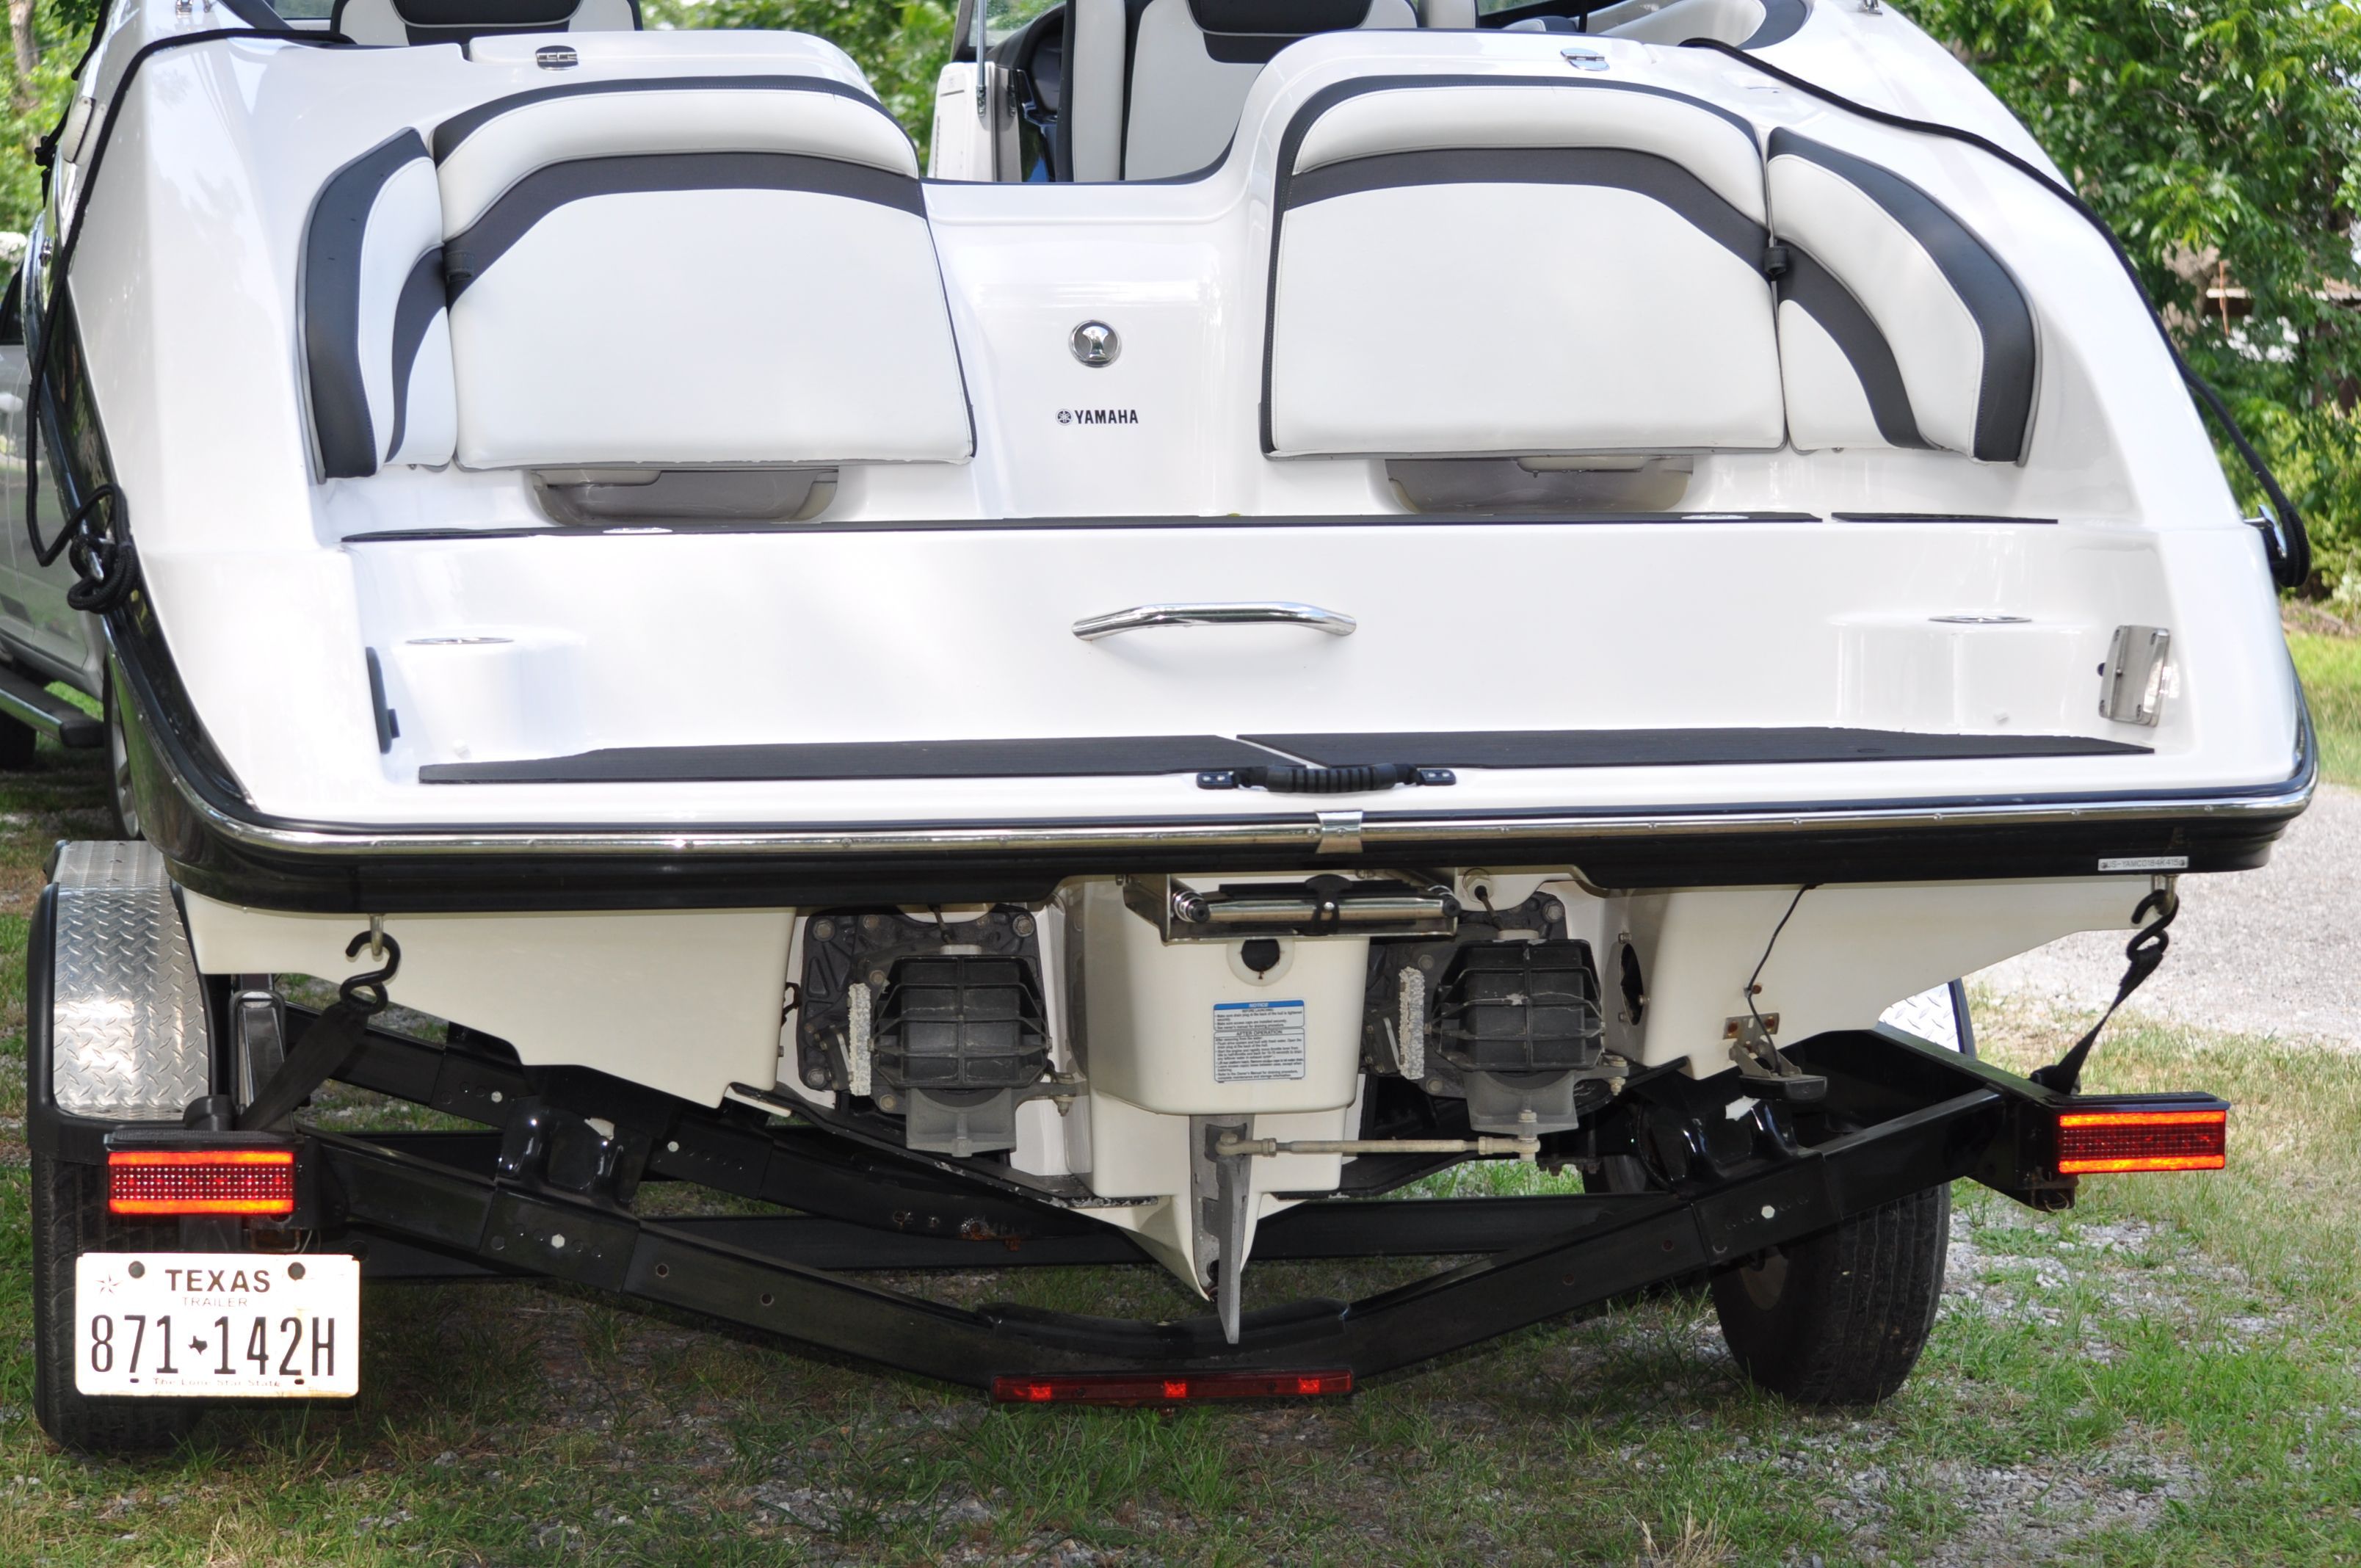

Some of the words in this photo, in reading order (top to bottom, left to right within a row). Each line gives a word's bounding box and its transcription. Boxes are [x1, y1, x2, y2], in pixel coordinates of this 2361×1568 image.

[1074, 410, 1139, 424] YAMAHA
[164, 1269, 270, 1293] TEXAS
[182, 1296, 248, 1307] TRAILER
